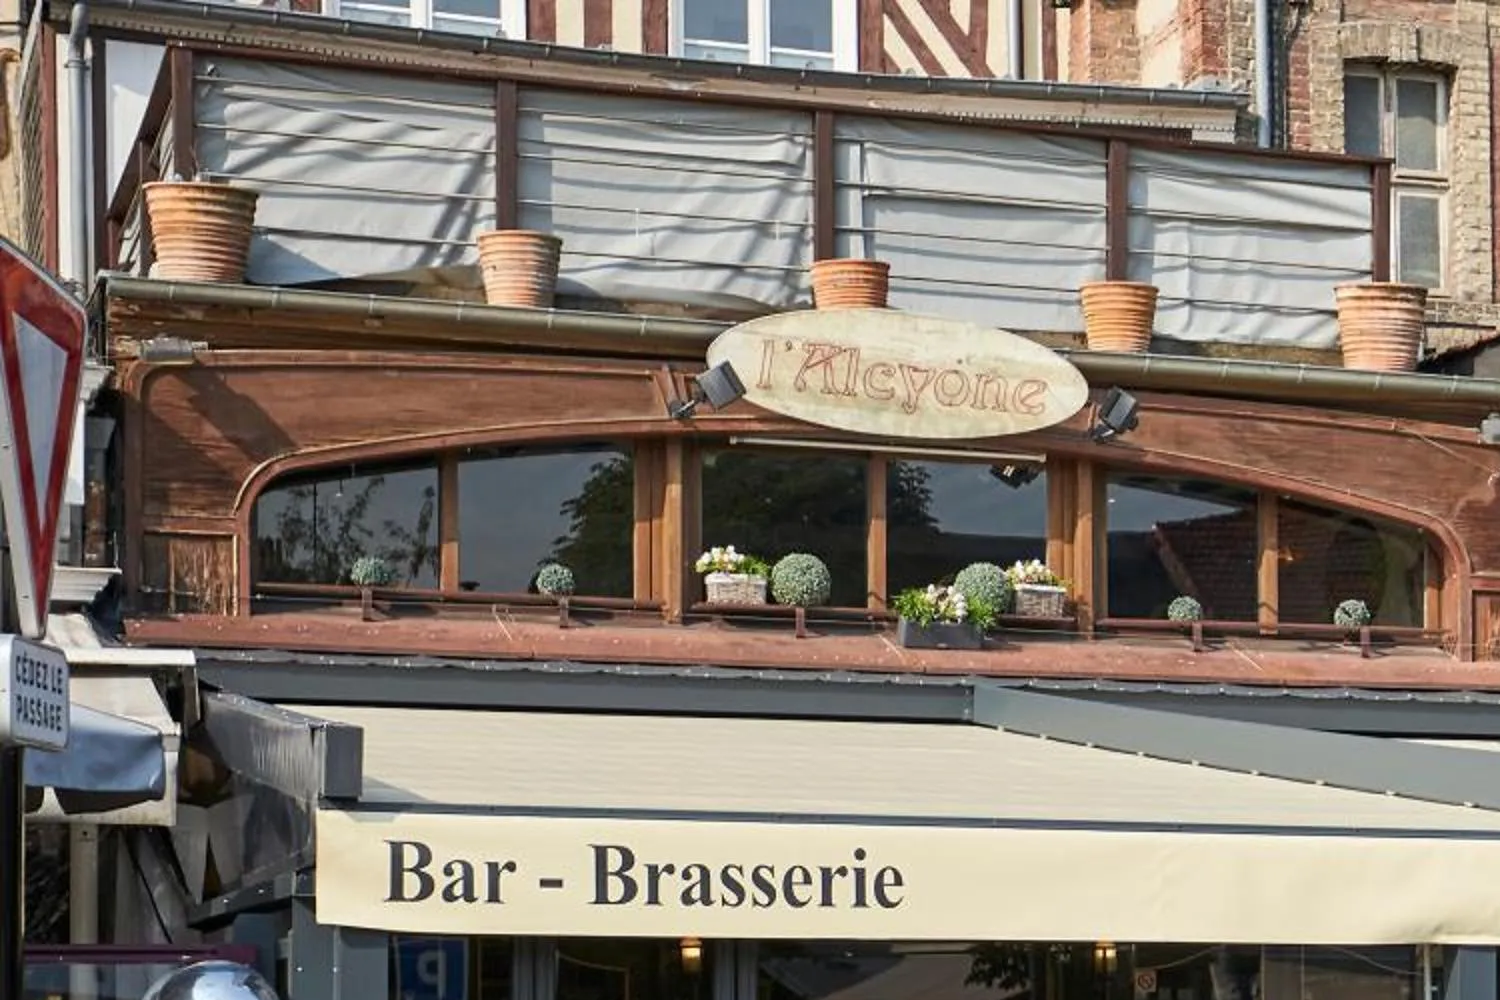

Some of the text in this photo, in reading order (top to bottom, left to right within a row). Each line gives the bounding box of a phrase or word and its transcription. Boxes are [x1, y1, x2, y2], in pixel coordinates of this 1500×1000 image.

[15, 652, 63, 695] CÉDEZ LE
[15, 694, 62, 733] PASSAGE
[384, 838, 517, 905] Bar
[587, 843, 905, 909] Brasserie
